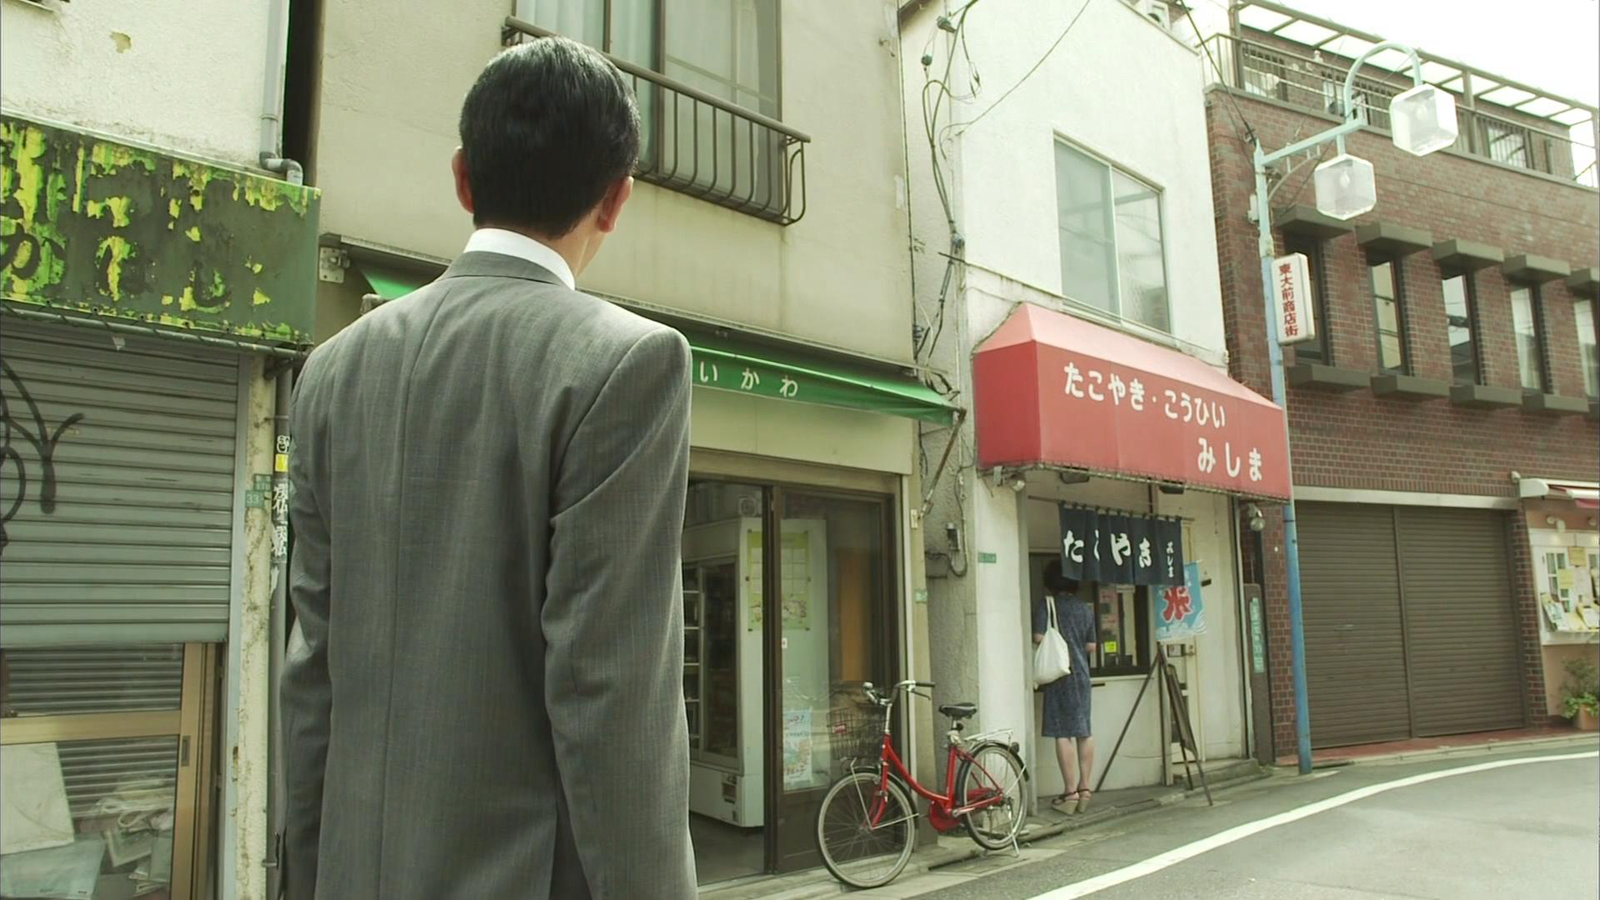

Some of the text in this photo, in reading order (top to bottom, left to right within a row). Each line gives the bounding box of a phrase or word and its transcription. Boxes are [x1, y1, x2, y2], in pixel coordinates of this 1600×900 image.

[1279, 263, 1298, 337] 東大前商店街
[699, 361, 798, 398] いかわ
[1197, 437, 1263, 482] みしま
